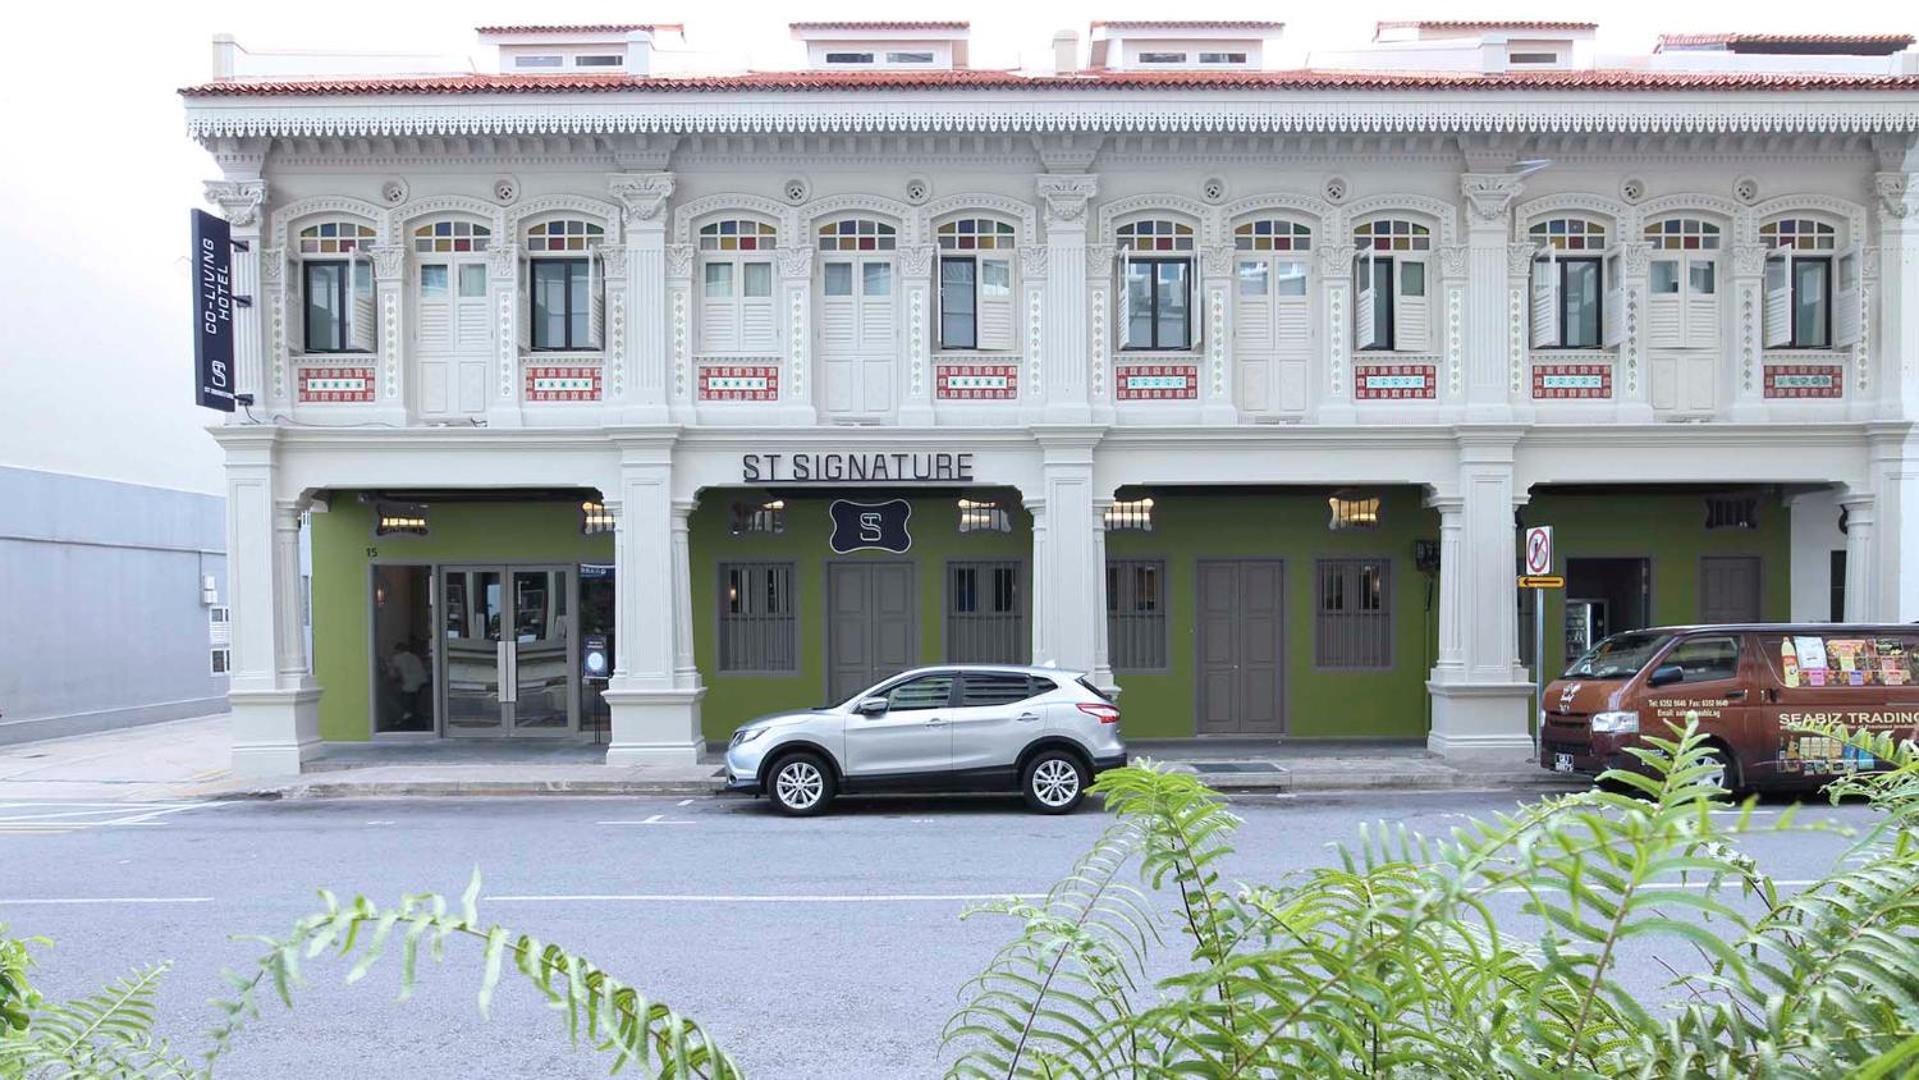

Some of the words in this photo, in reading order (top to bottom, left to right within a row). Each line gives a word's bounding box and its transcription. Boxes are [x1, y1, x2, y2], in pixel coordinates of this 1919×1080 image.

[203, 238, 217, 335] CO-LIVING
[217, 264, 230, 322] HOTEL
[743, 453, 781, 480] ST
[793, 453, 973, 481] SIGNATURE
[366, 547, 378, 558] 15
[1779, 712, 1843, 726] SEABIZ
